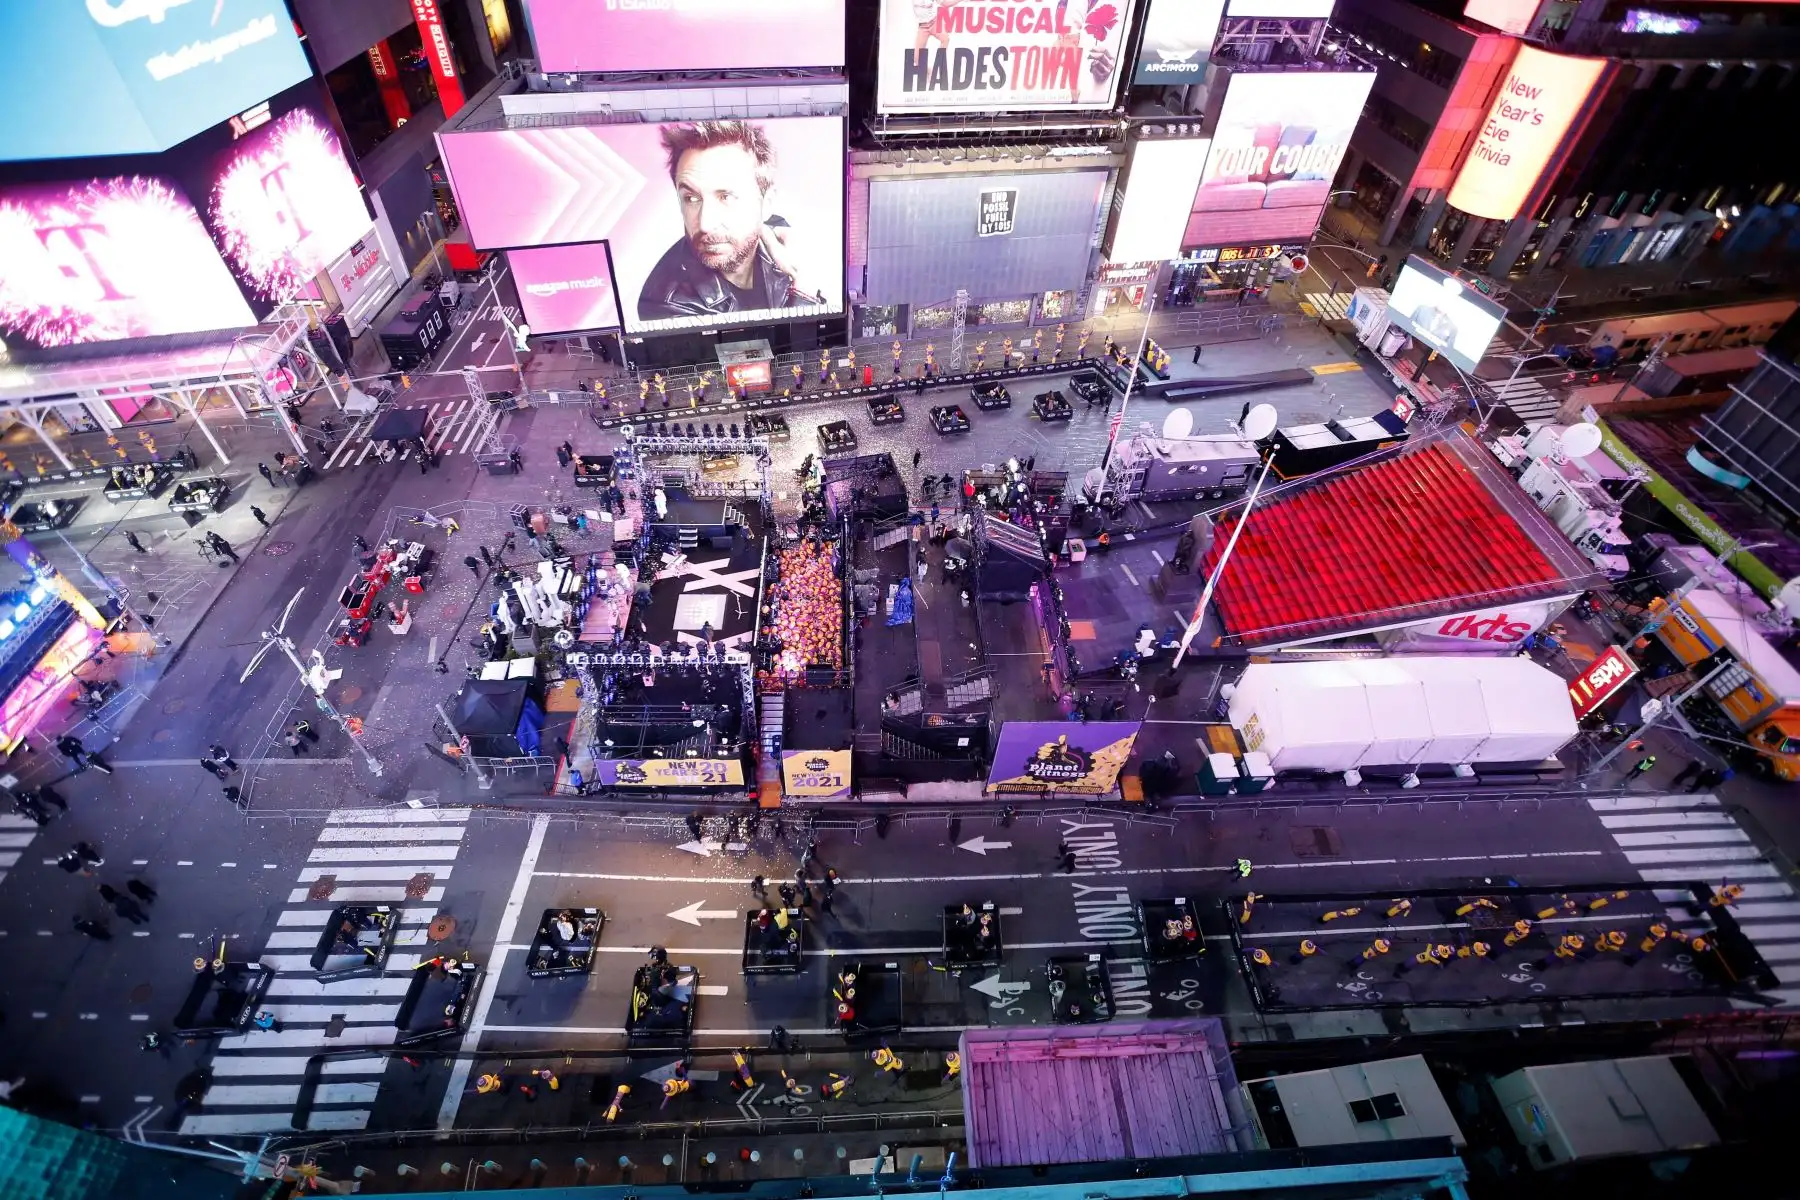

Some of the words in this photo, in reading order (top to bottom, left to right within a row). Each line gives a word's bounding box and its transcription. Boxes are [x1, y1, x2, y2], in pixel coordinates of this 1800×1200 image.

[936, 6, 1072, 34] MUSICAL
[902, 45, 1084, 93] HADESTOWN
[1144, 63, 1199, 73] ARCIMOTO
[1505, 74, 1543, 100] New
[1496, 96, 1544, 126] Year's
[1483, 119, 1510, 142] Eve
[1216, 146, 1271, 178] YOUR
[1474, 139, 1511, 166] Trivia
[570, 275, 606, 290] music
[1438, 613, 1532, 643] tkts
[1589, 656, 1625, 690] tkts
[654, 768, 699, 776] YEAR'S
[668, 761, 697, 769] NEW
[1029, 763, 1079, 774] planet
[1034, 769, 1087, 778] fitness
[792, 776, 844, 788] 2021
[1061, 819, 1122, 869] ONLY
[1072, 883, 1138, 939] ONLY
